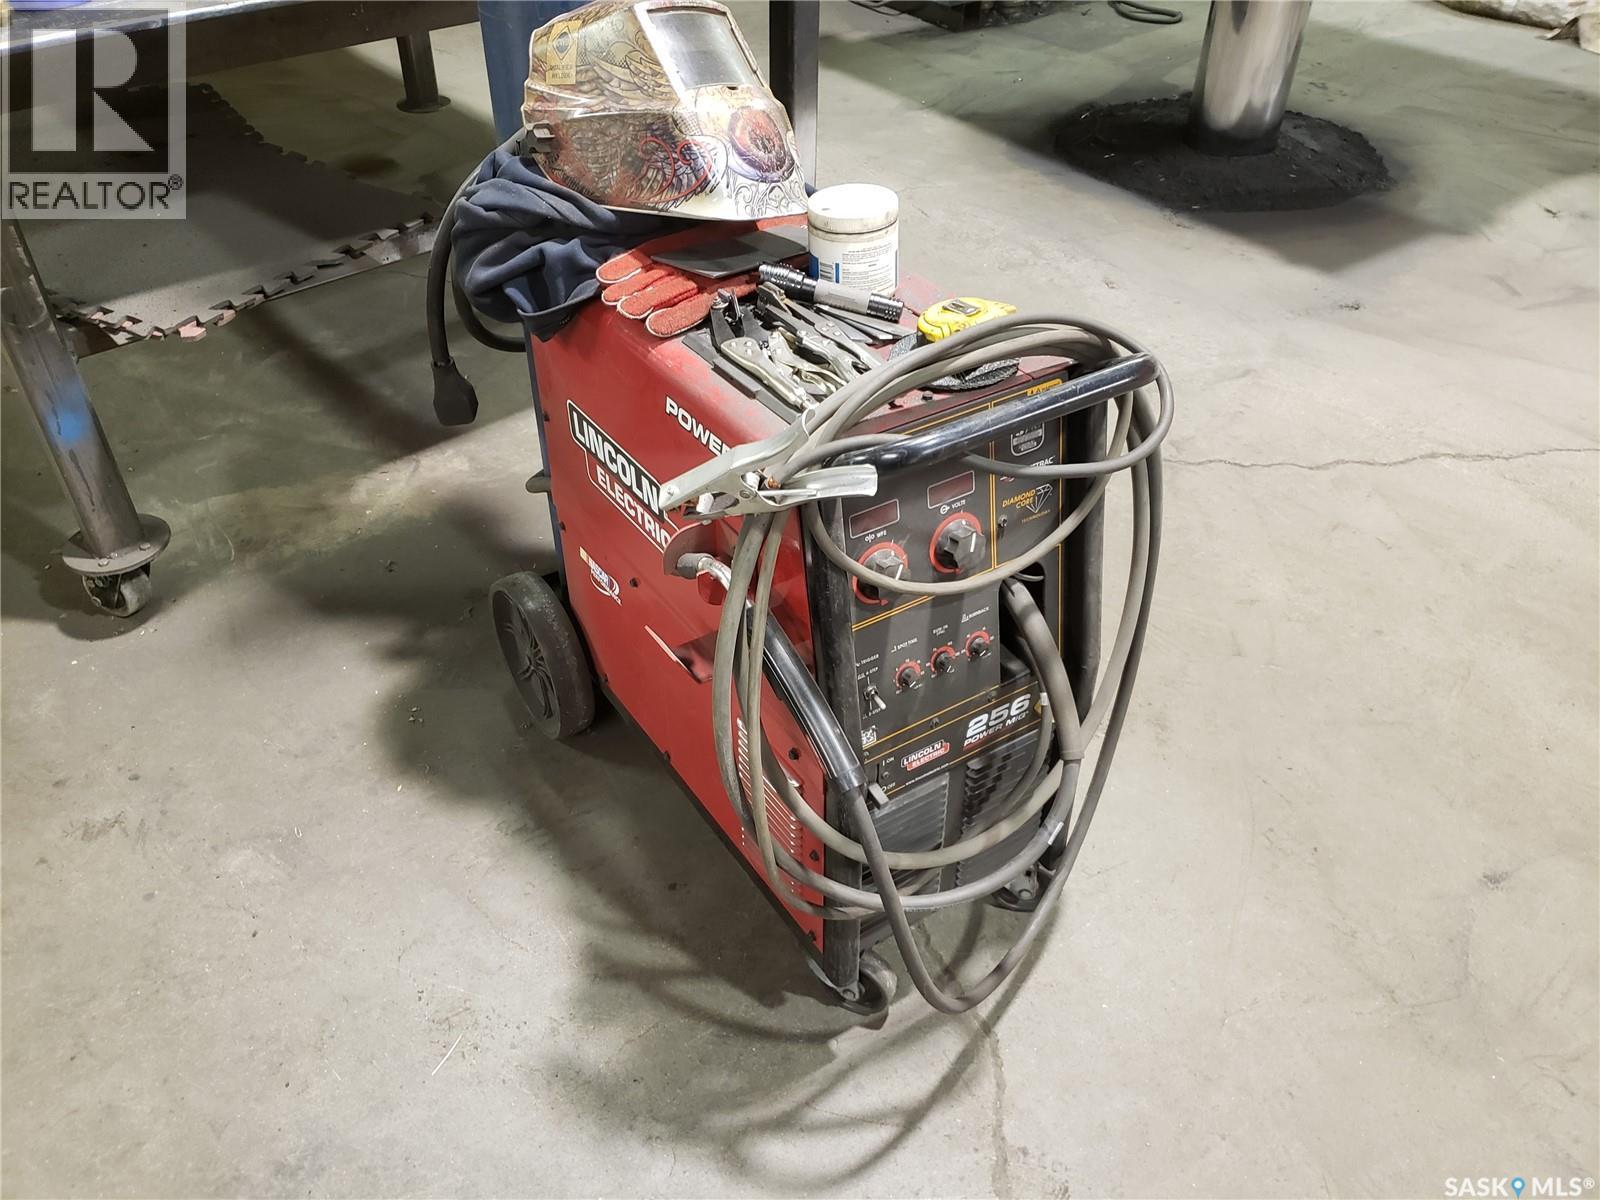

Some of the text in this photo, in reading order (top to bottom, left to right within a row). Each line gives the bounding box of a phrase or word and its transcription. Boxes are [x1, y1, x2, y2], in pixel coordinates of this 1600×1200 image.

[573, 411, 660, 516] LINCOLN
[1002, 489, 1036, 508] DIAMOND
[1015, 496, 1034, 509] CORE
[966, 693, 1031, 738] 256
[963, 723, 1003, 747] POWER
[903, 741, 942, 766] LINCOLN
[912, 748, 945, 767] ELECTRIC
